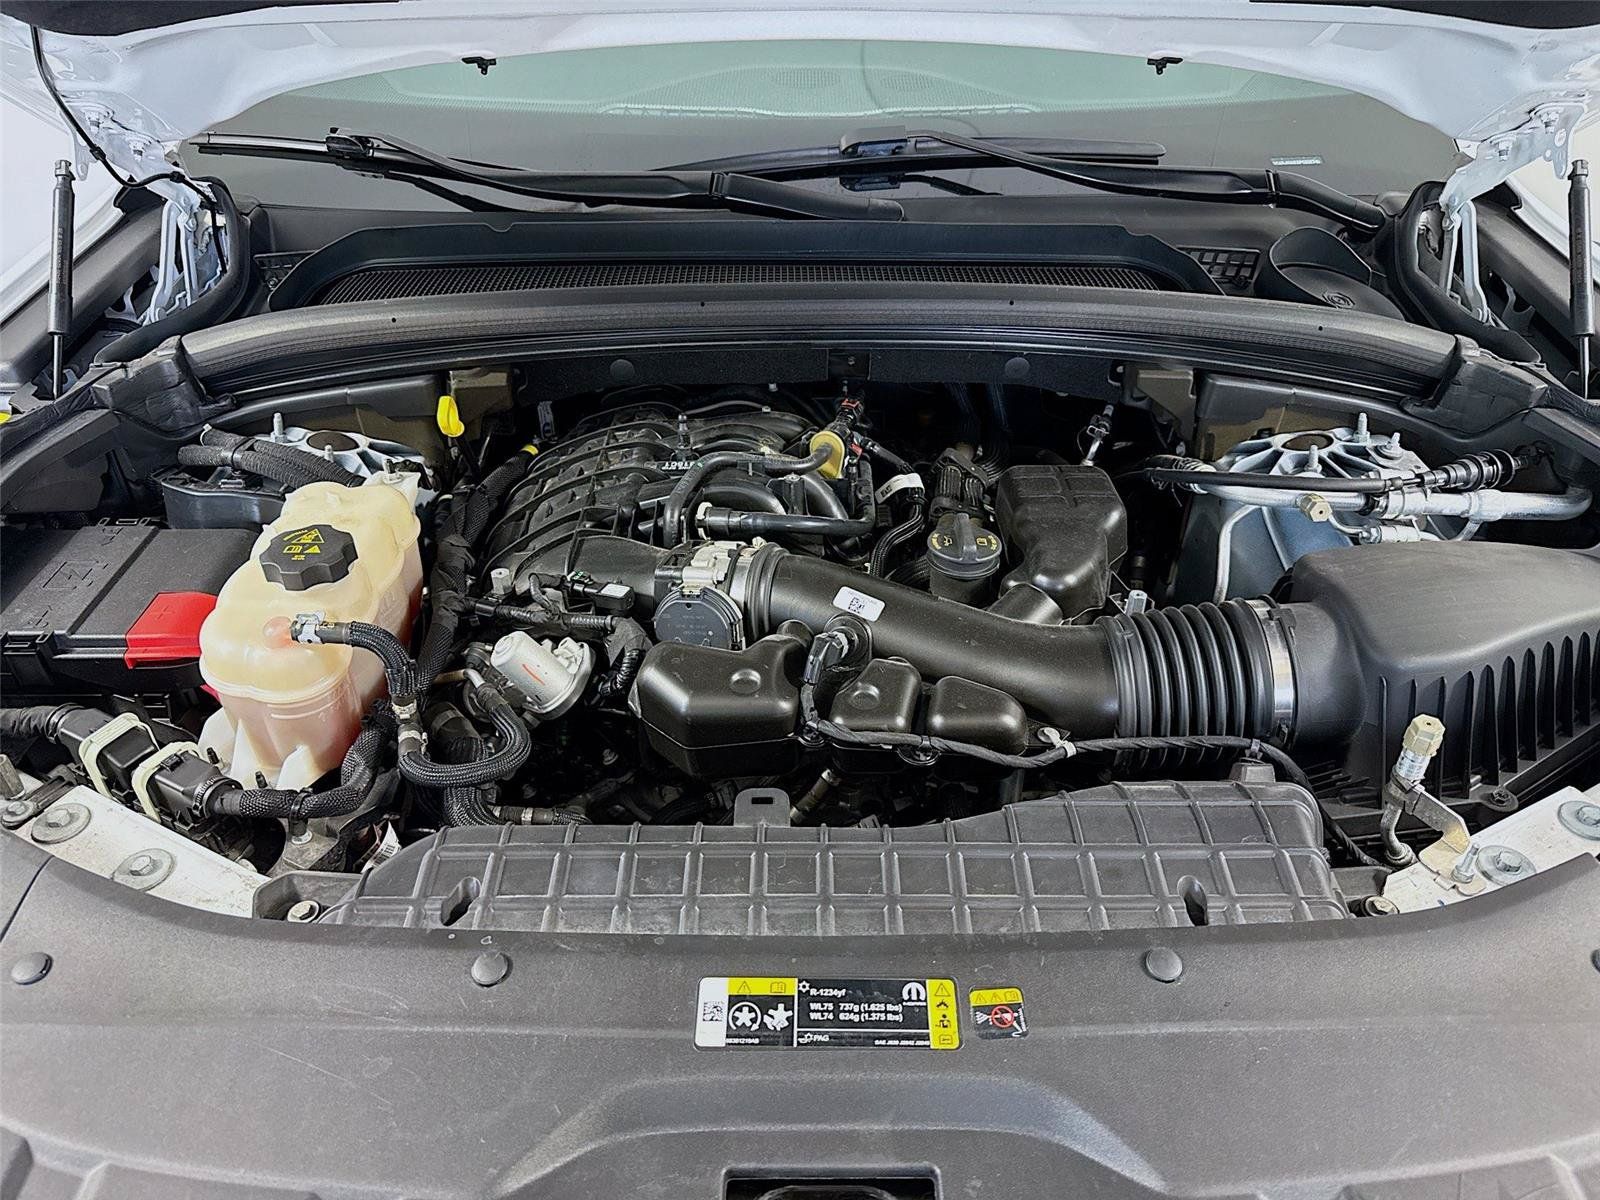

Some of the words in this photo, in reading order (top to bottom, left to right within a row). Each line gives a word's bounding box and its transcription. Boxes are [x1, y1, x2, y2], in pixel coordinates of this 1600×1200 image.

[809, 988, 847, 998] R-1234yf
[809, 1002, 834, 1011] WL75
[838, 1003, 860, 1013] 737g
[886, 1003, 903, 1013] lbs)
[809, 1012, 834, 1020] WL74
[838, 1012, 860, 1022] 624g
[886, 1013, 903, 1023] lbs)
[813, 1034, 830, 1042] PAG
